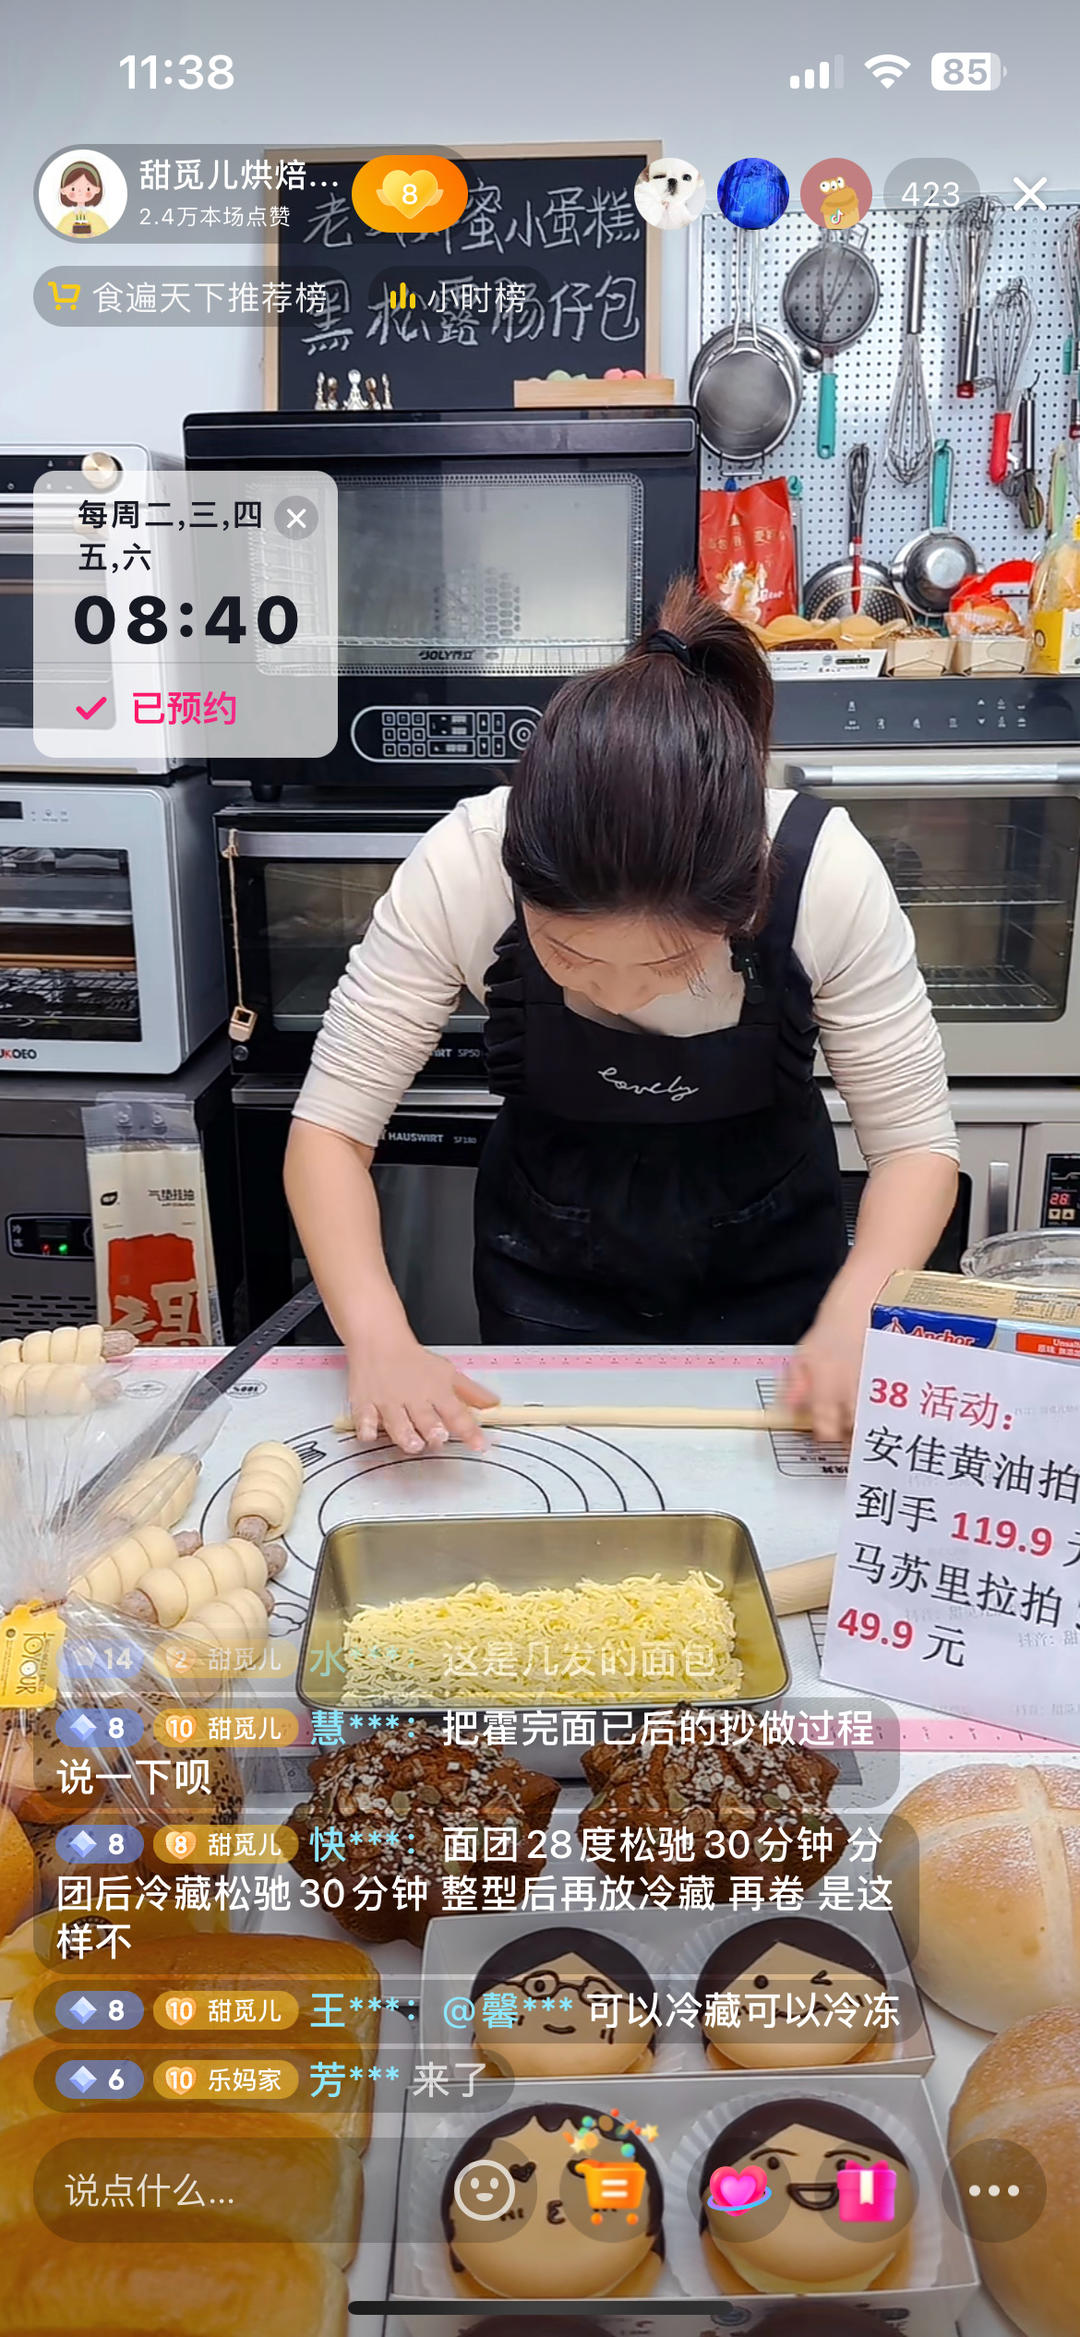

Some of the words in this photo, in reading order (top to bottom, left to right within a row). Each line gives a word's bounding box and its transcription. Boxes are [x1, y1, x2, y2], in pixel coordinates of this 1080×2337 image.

[303, 178, 641, 255] 老蜜小蛋糕
[388, 1132, 444, 1143] HAUSWIRT
[868, 1377, 910, 1409] 38
[919, 1380, 1014, 1432] 活动：
[863, 1425, 1080, 1505] 安佳黄油拍
[855, 1484, 938, 1533] 到手
[950, 1511, 1053, 1557] 119.9
[848, 1541, 1063, 1629] 马苏里拉拍
[836, 1607, 914, 1651] 49.9
[922, 1623, 966, 1667] 元
